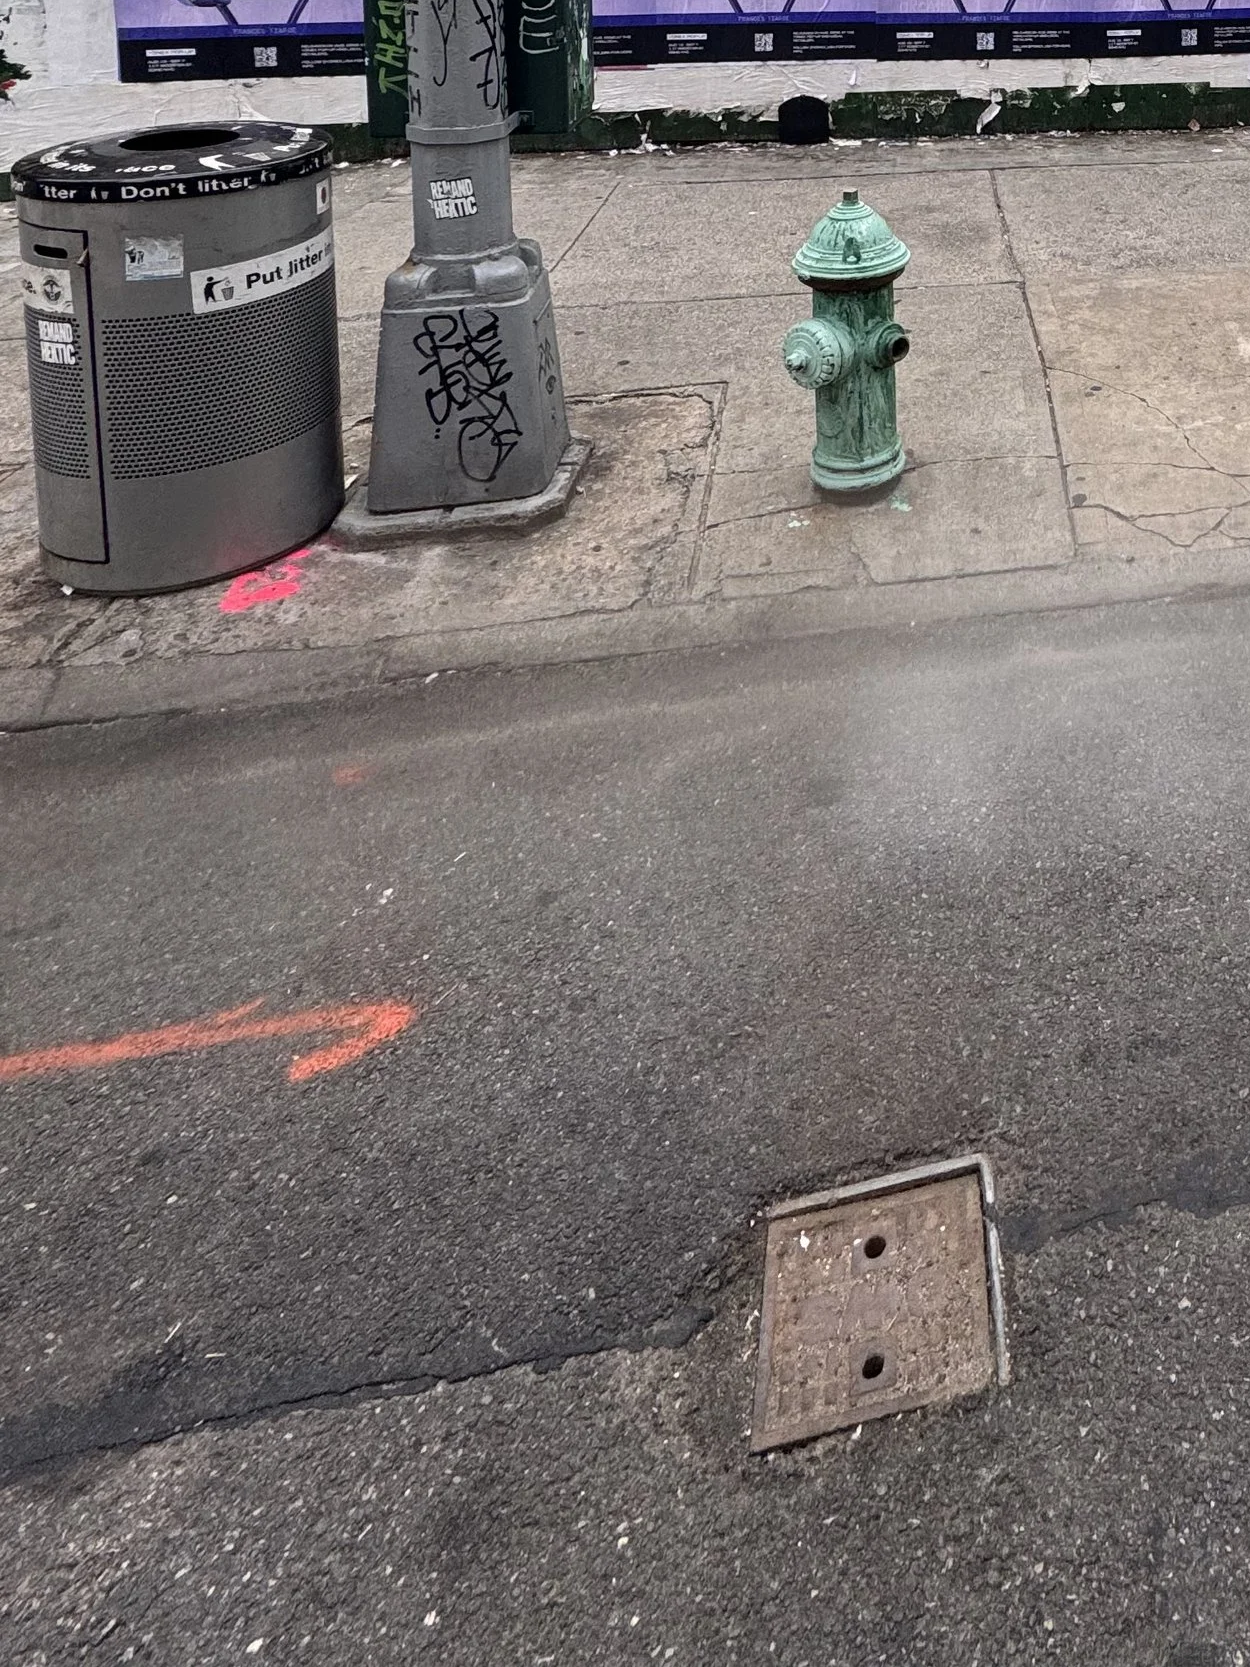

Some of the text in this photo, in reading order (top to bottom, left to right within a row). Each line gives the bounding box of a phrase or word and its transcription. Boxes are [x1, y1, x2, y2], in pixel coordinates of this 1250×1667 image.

[41, 184, 78, 199] tter
[121, 182, 187, 199] Don't
[429, 178, 475, 200] REMAND
[433, 196, 478, 219] HEKTIC
[246, 267, 283, 289] Put
[289, 246, 323, 276] litter
[38, 320, 73, 343] REMAND
[41, 343, 76, 364] HEKTIC
